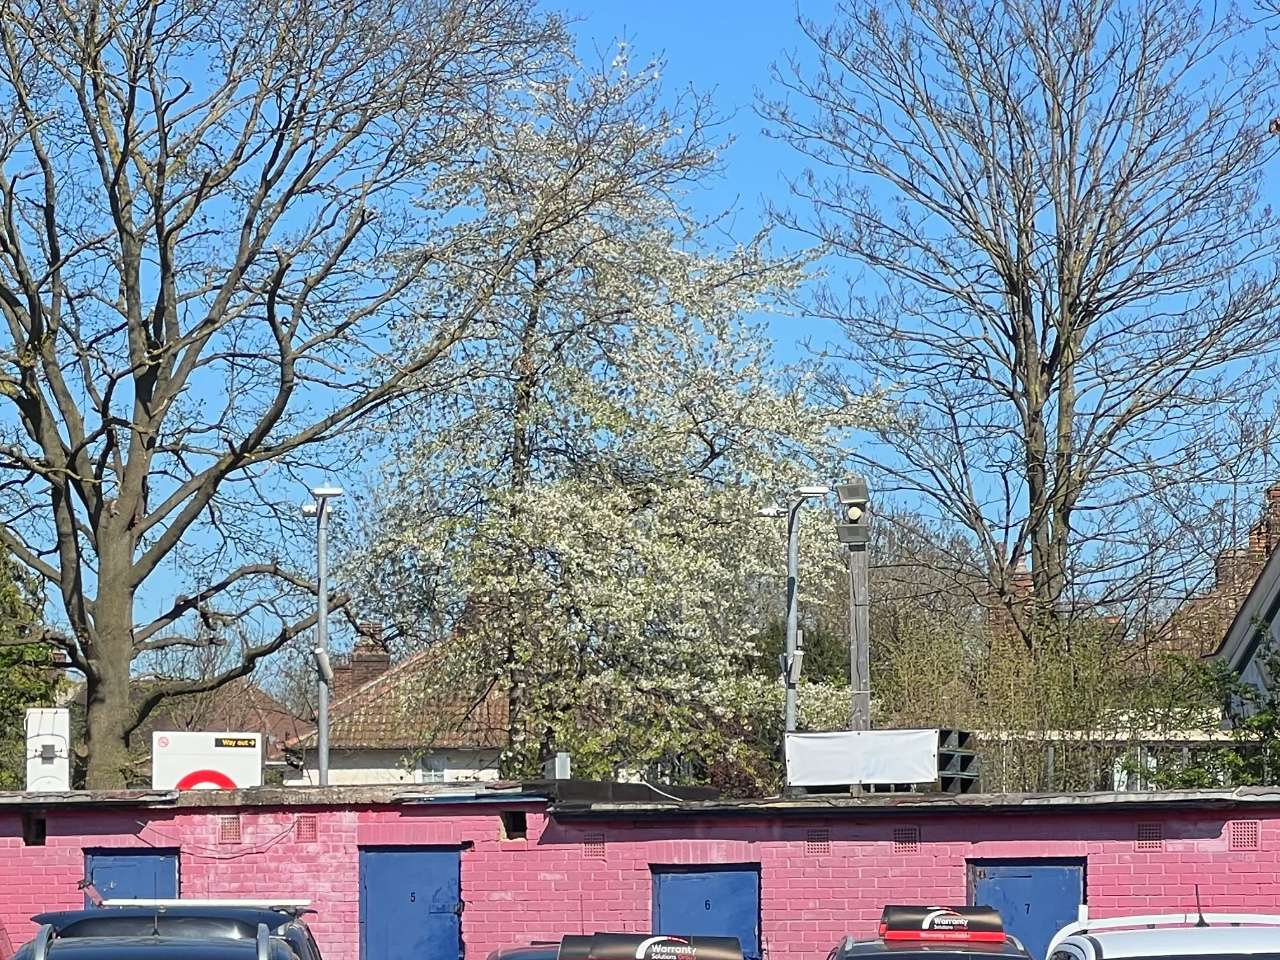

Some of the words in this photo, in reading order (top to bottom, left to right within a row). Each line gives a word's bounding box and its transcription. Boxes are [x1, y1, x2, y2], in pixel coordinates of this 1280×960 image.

[410, 892, 416, 903] 5
[704, 899, 711, 911] 6
[1024, 903, 1031, 915] 7
[934, 917, 969, 927] Warranty
[651, 944, 697, 956] Warranty
